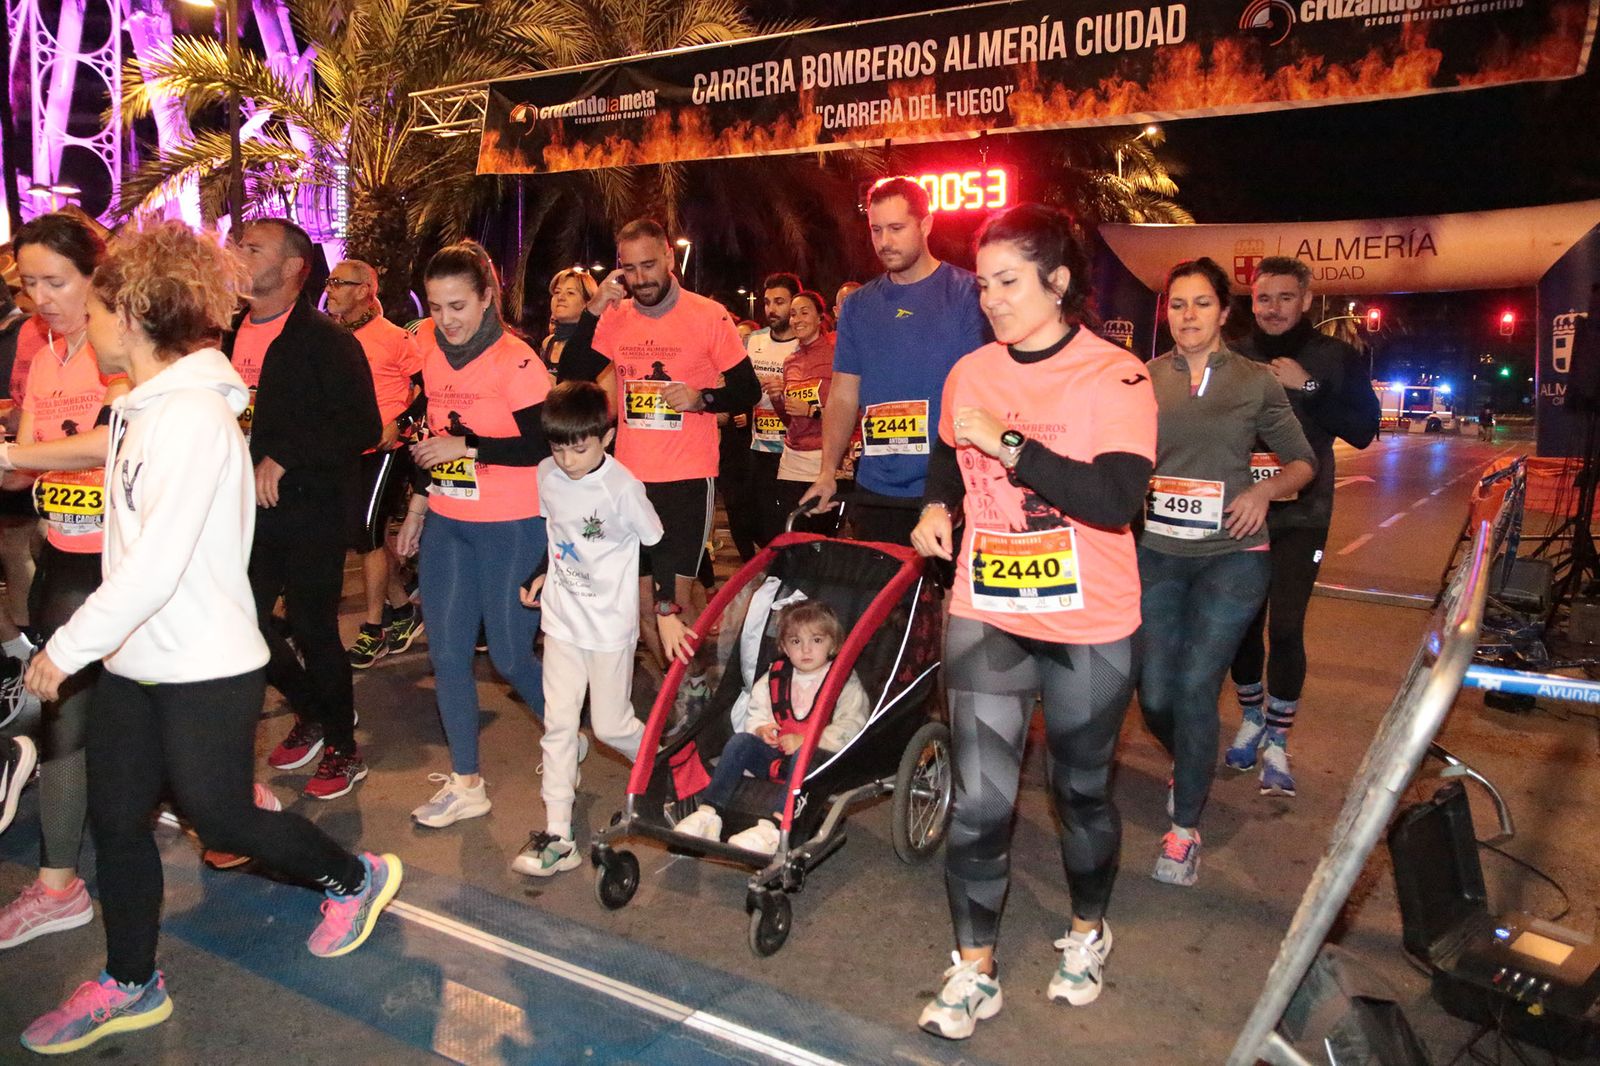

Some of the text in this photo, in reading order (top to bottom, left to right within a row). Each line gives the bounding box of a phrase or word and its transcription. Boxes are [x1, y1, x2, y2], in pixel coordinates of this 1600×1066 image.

[691, 3, 1187, 105] CARRERA BOMBEROS ALMERÍA CIUDAD
[908, 93, 942, 121] DEL
[1295, 228, 1438, 262] ALMERÍA
[1312, 265, 1365, 281] UDAD
[1540, 383, 1568, 396] ALM
[1552, 397, 1565, 406] CI
[759, 418, 781, 427] 2437
[877, 417, 917, 433] 2441
[48, 487, 103, 508] 2223
[1164, 496, 1203, 514] 498
[991, 558, 1060, 580] 2440
